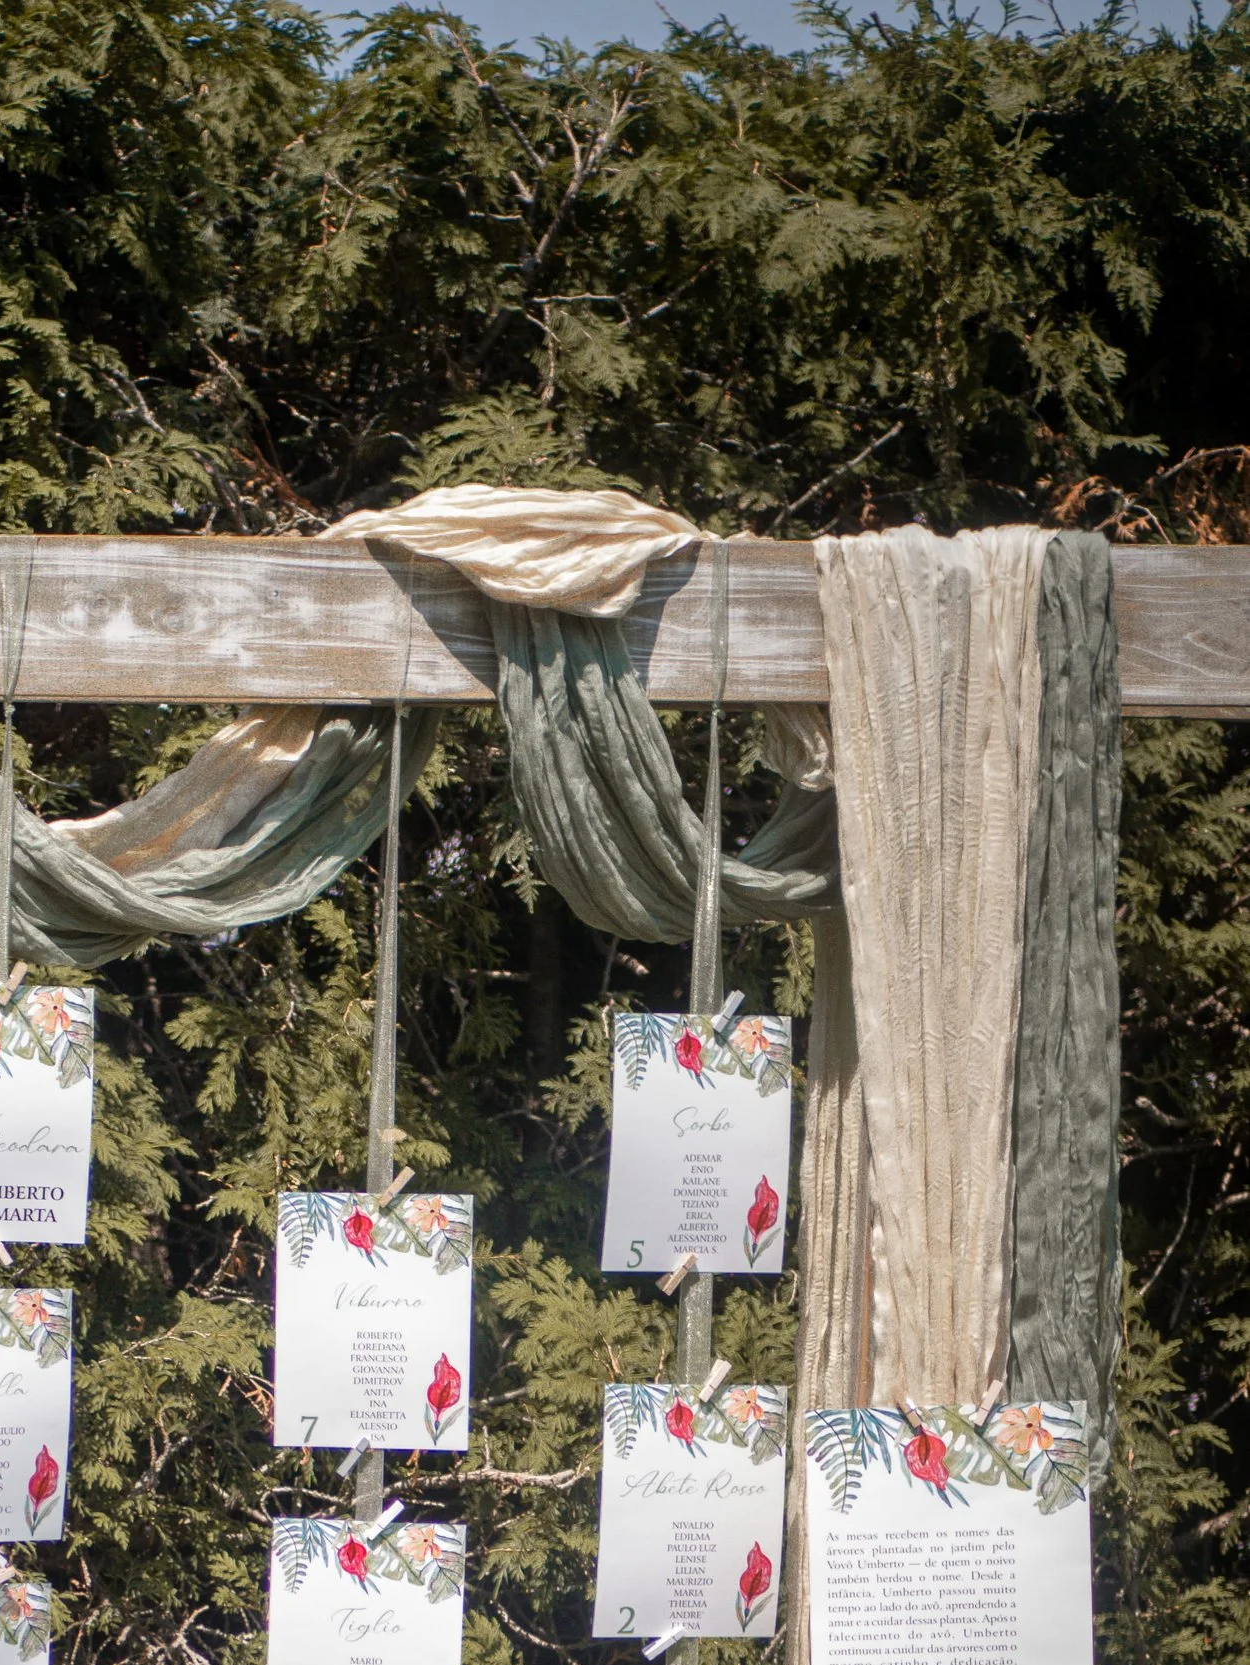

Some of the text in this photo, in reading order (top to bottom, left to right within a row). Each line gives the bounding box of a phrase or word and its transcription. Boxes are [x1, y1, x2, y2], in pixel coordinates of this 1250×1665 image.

[673, 1106, 734, 1137] Sorbo
[683, 1154, 722, 1162] ADEMAR
[674, 1189, 727, 1198] DOMINIQUE
[681, 1200, 719, 1208] TIZIANO
[678, 1223, 718, 1231] ALBERTO
[627, 1240, 644, 1268] 5
[334, 1282, 426, 1310] Viburno
[357, 1332, 402, 1340] ROBERTO
[353, 1366, 404, 1374] GIOVANNA
[354, 1377, 403, 1385] DIMITROV
[351, 1411, 406, 1419] ELISABETTA
[301, 1416, 318, 1443] 7
[620, 1469, 767, 1499] Abete Rosso
[675, 1533, 710, 1541] EDILMA
[826, 1532, 839, 1541] As
[847, 1533, 878, 1541] mesas
[886, 1530, 929, 1539] recebem
[955, 1529, 989, 1537] nomes
[997, 1527, 1015, 1536] das
[872, 1545, 923, 1557] plantadas
[951, 1542, 985, 1554] jardim
[993, 1542, 1015, 1553] pelo
[666, 1578, 713, 1586] MAURIZIO
[669, 1600, 707, 1608] THELMA
[331, 1607, 405, 1642] Tiglio
[617, 1607, 635, 1634] 2
[350, 1657, 382, 1665] MARIO
